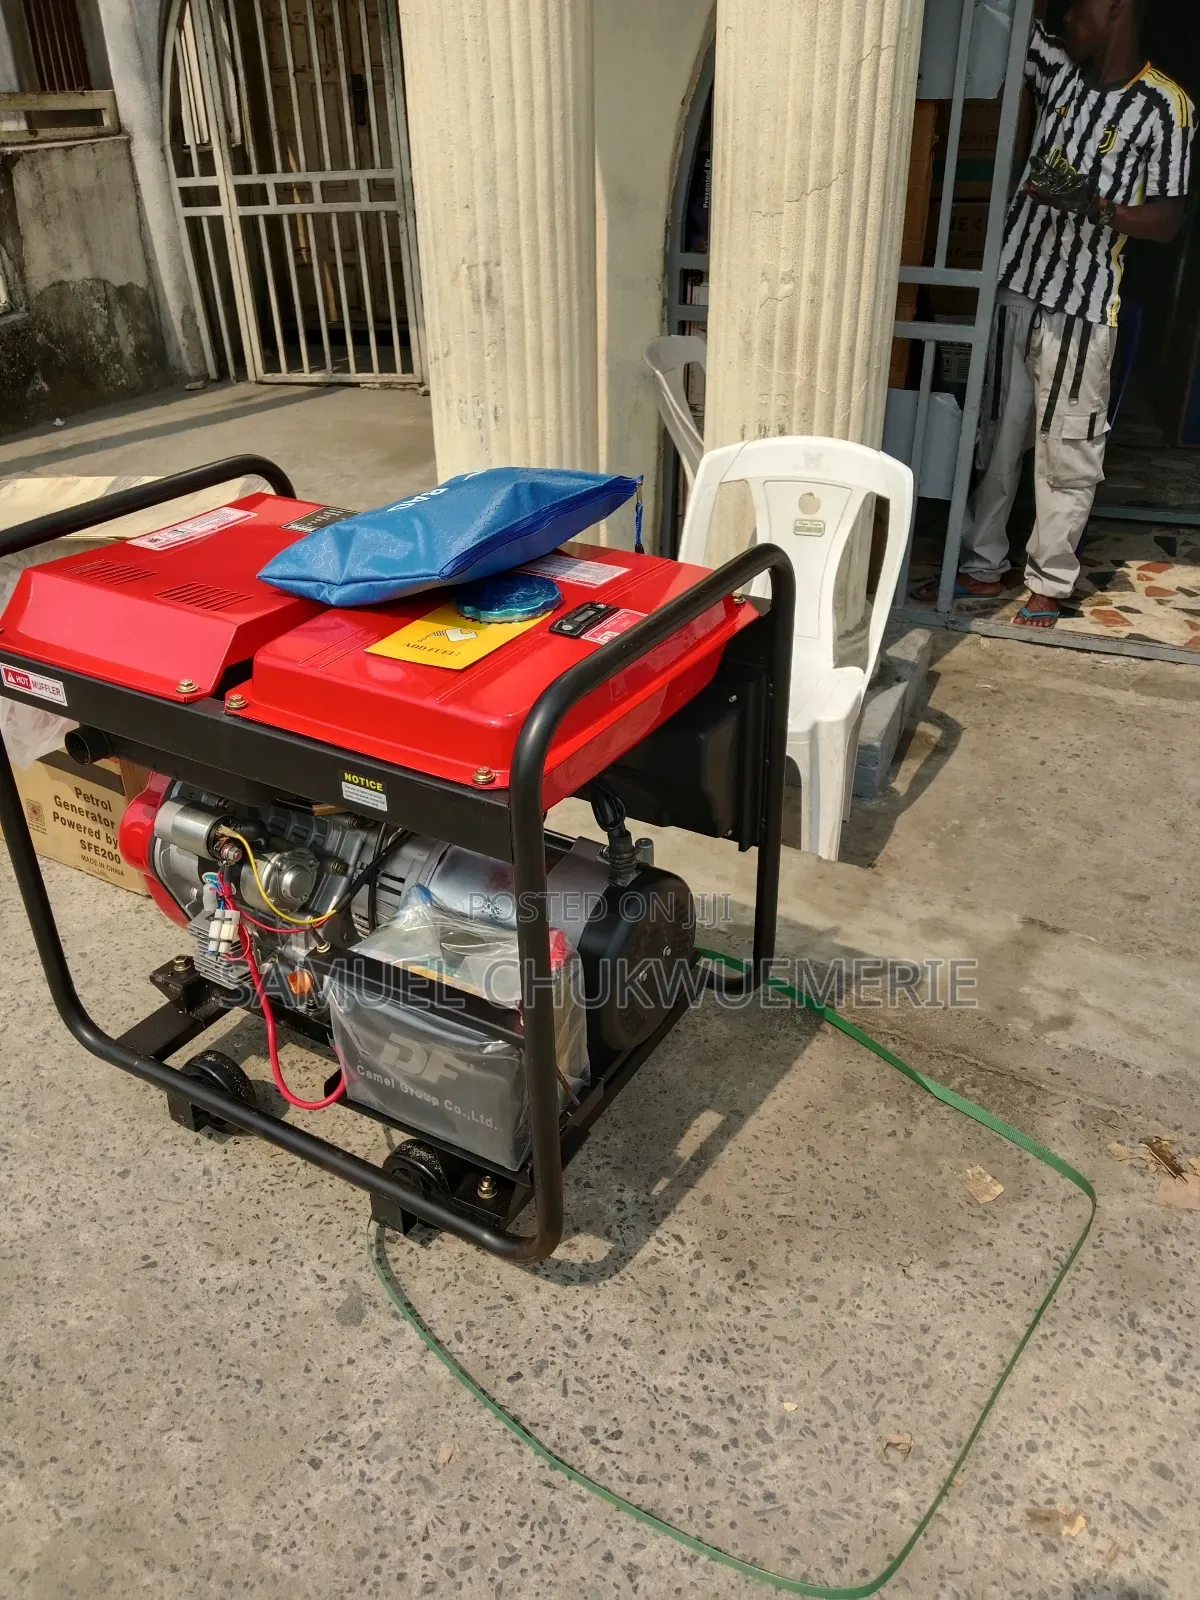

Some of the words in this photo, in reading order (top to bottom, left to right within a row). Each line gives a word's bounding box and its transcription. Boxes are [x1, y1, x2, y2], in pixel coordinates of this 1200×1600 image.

[32, 680, 62, 697] MUFFLER
[344, 772, 383, 792] NOTICE
[53, 795, 115, 830] Generator
[74, 786, 112, 813] Petrol
[52, 811, 101, 841] Powered
[105, 833, 118, 850] by
[79, 839, 121, 865] SFE200
[80, 854, 98, 868] MADE
[98, 861, 106, 869] IN
[106, 865, 125, 878] CHINA
[356, 1064, 395, 1089] Camel
[400, 1081, 440, 1107] Group
[444, 1099, 498, 1131] Co.,Ltd.
